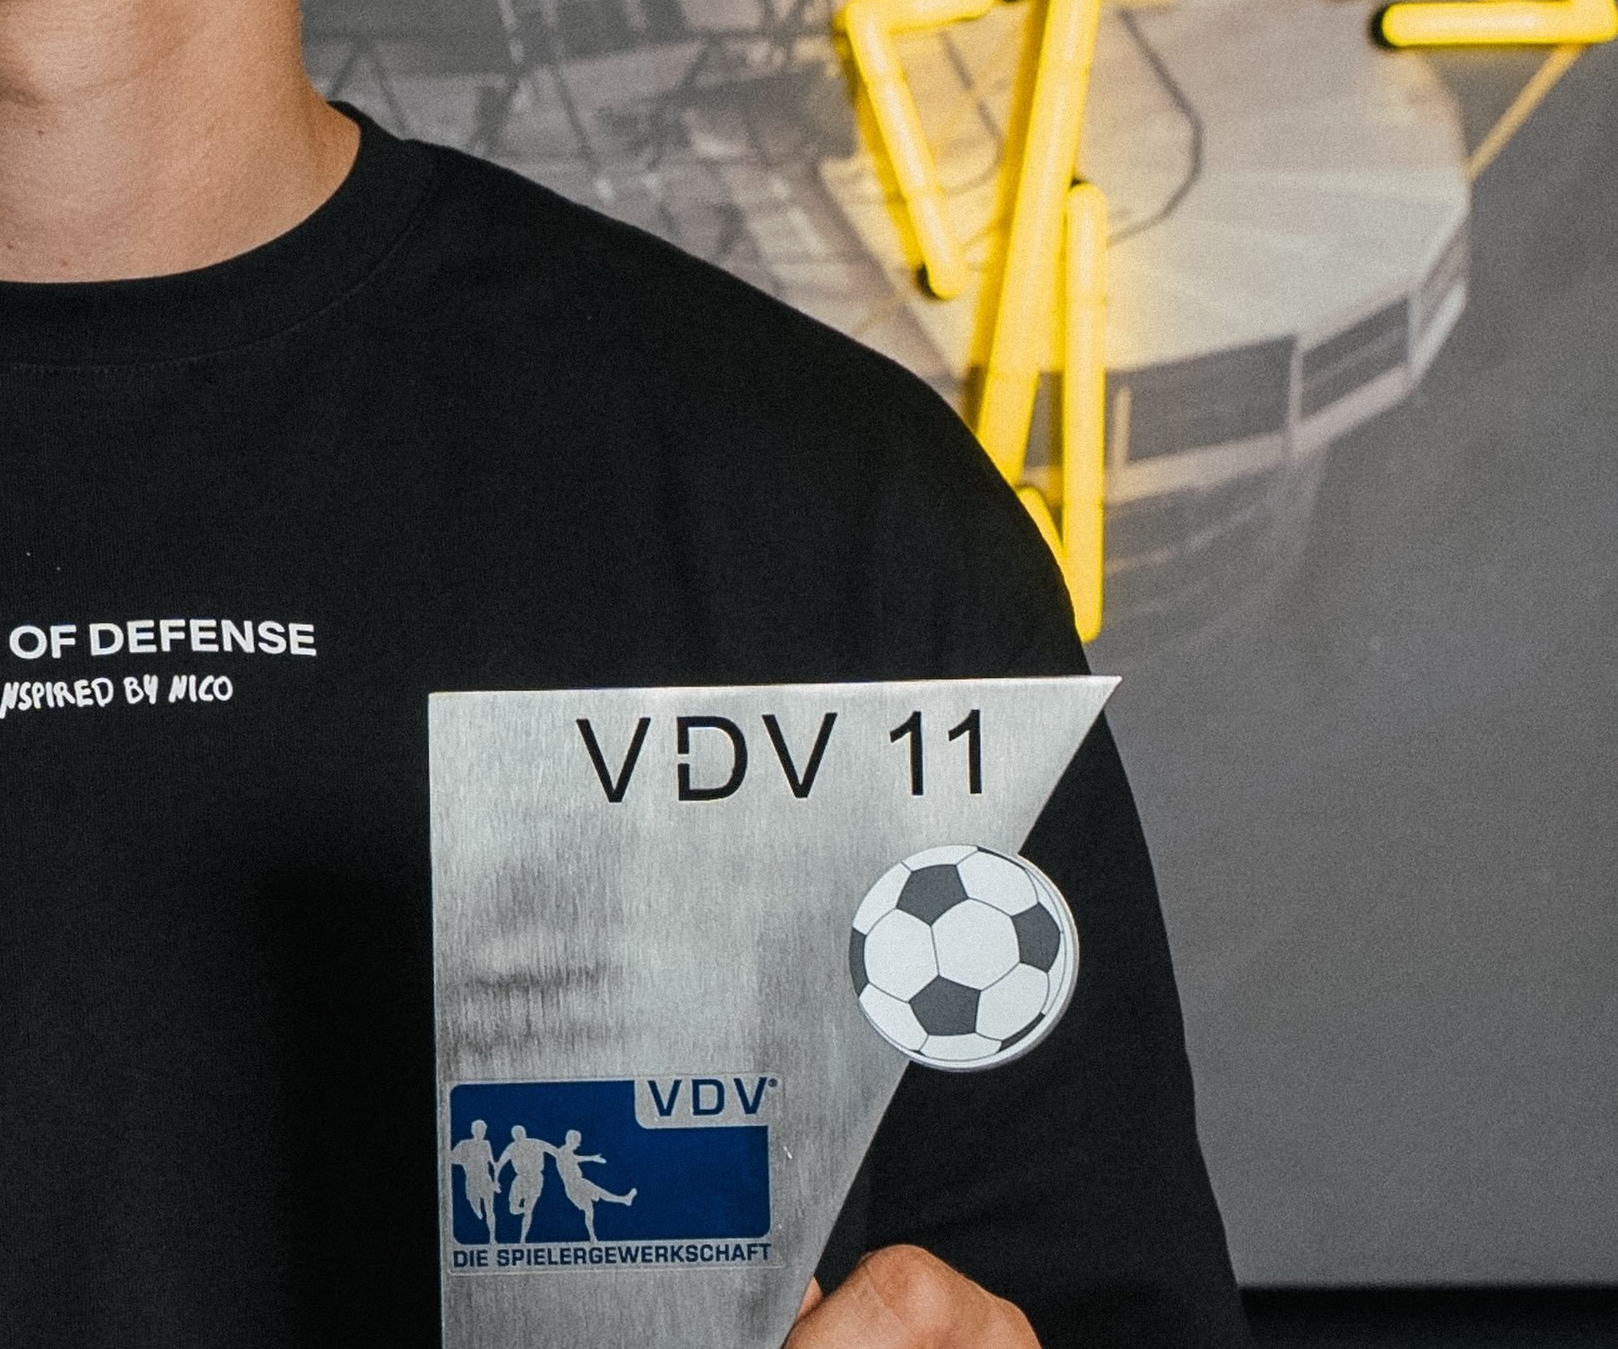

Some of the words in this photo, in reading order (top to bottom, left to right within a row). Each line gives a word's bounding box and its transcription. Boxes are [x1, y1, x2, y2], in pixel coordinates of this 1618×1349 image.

[8, 624, 77, 660] OF
[88, 618, 318, 657] DEFENSE
[123, 674, 159, 705] BY
[167, 674, 234, 703] NICO
[575, 711, 839, 804] VDV
[888, 708, 983, 797] 11
[453, 1249, 489, 1268] DIE
[496, 1243, 772, 1267] SPIELERGEWERKSCHAFT
